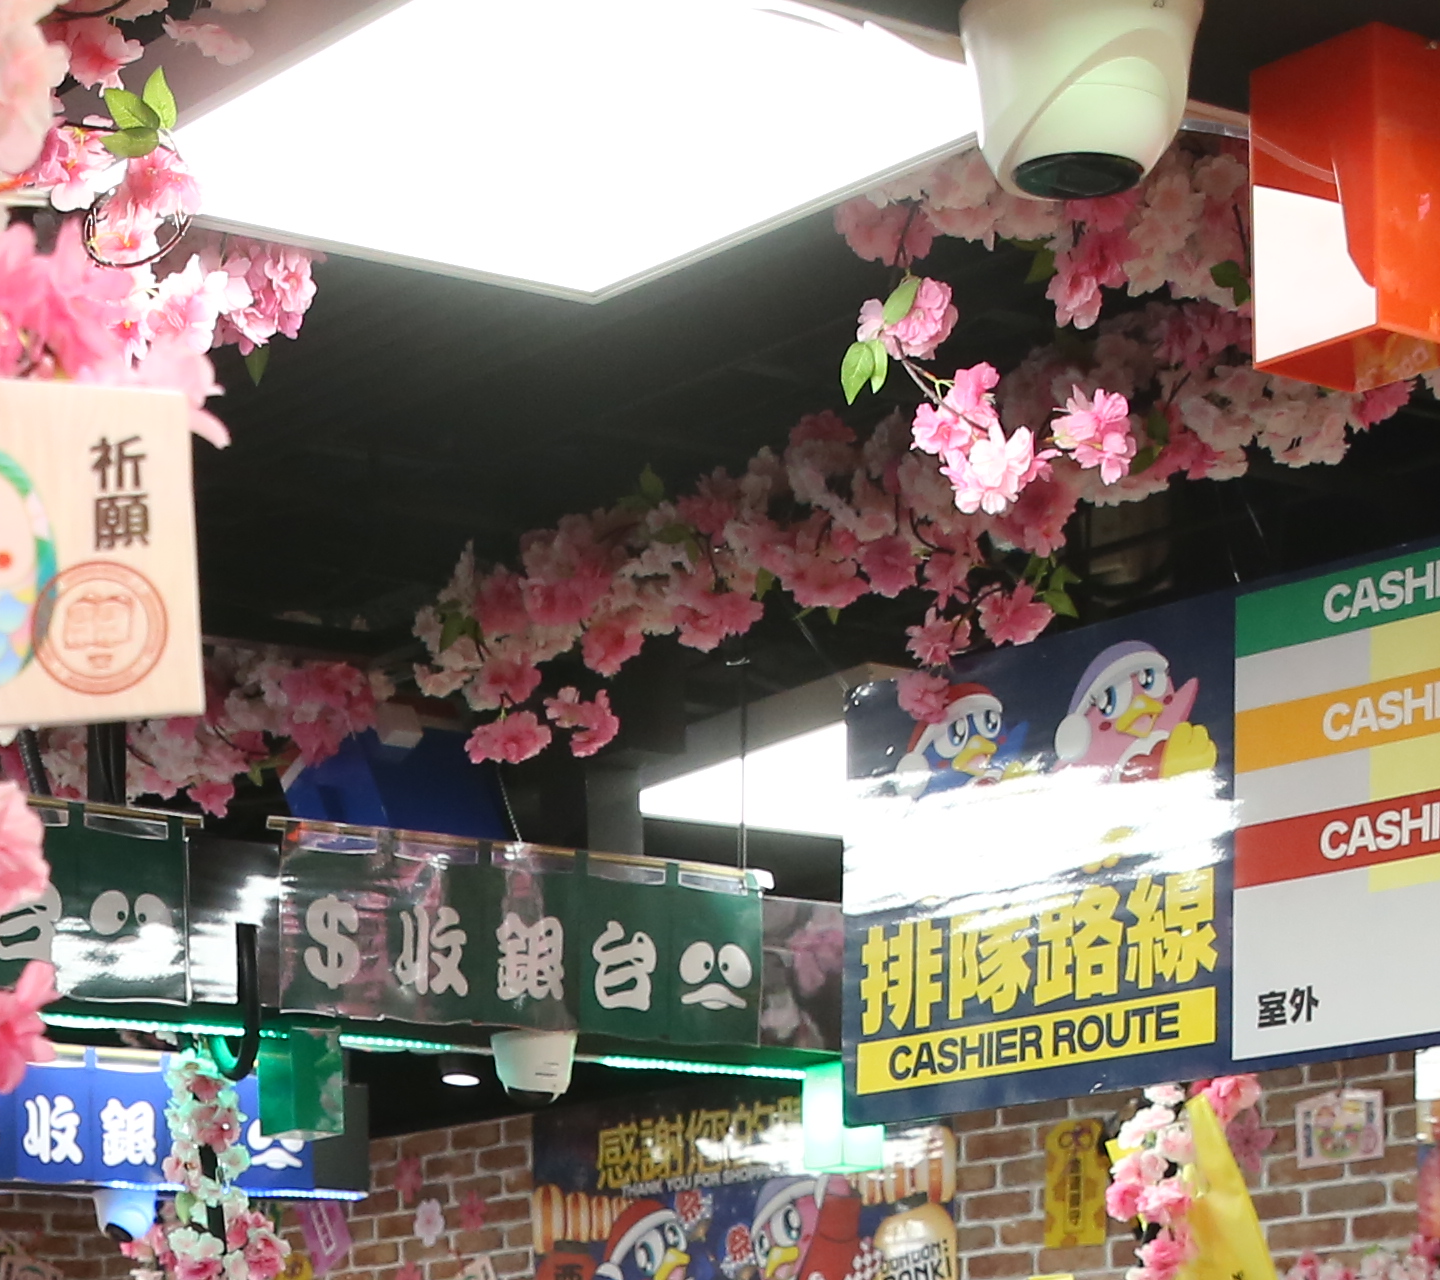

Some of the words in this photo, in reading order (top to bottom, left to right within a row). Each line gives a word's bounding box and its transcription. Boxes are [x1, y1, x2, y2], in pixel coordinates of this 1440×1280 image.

[89, 434, 151, 551] 祈願
[860, 866, 1218, 1037] 排隊路線
[1257, 985, 1320, 1029] 室外
[889, 1030, 1044, 1081] CASHIER
[1051, 1008, 1180, 1059] ROUTE
[621, 1179, 663, 1198] THANK
[667, 1175, 692, 1192] YOU
